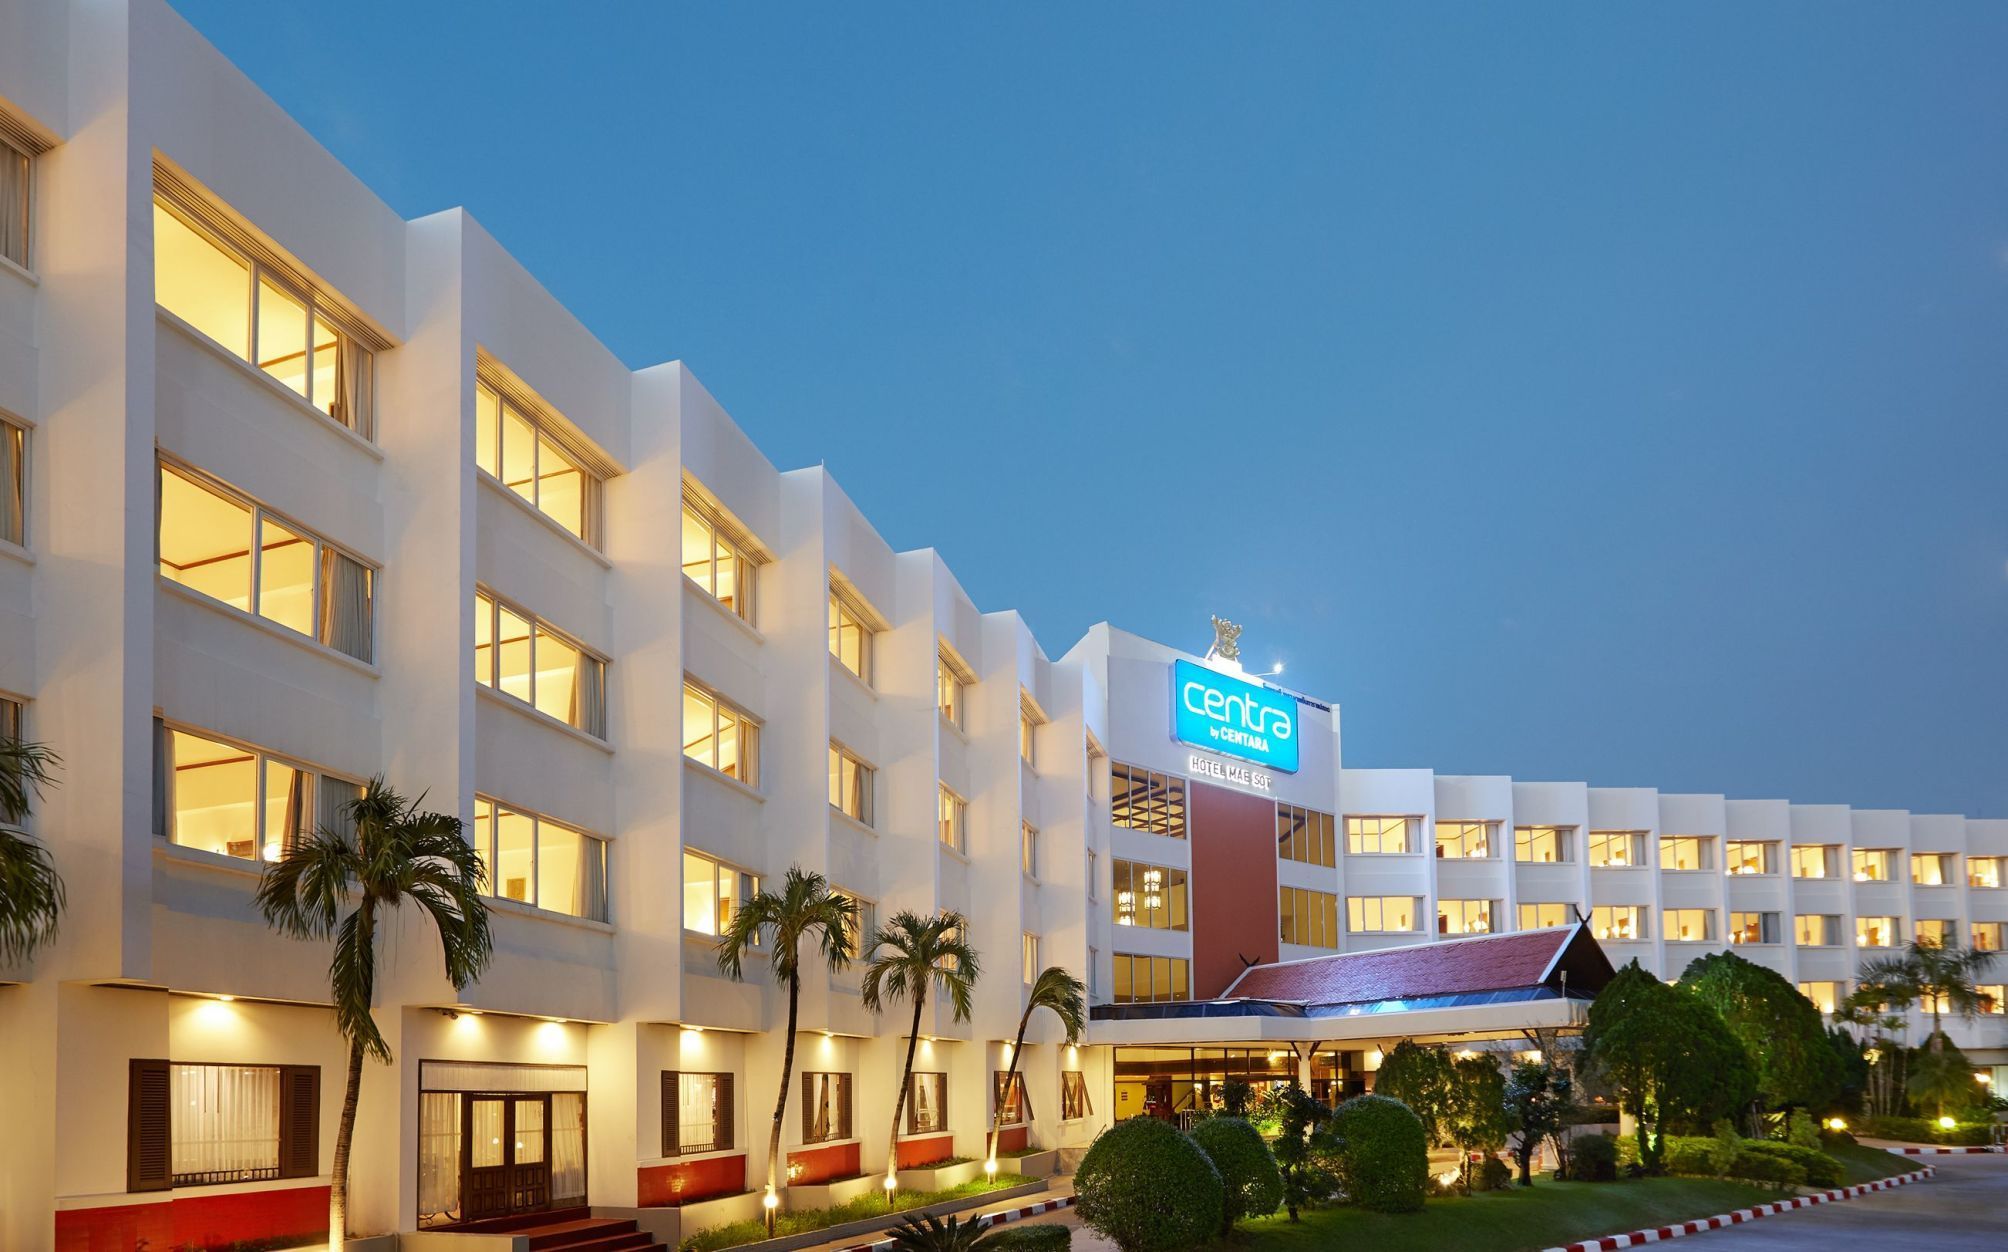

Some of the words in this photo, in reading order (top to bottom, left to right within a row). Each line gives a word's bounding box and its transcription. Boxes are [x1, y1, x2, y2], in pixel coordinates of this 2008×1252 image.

[1184, 681, 1291, 739] centra
[1210, 726, 1219, 740] by
[1220, 726, 1269, 752] CENTARA
[1190, 756, 1225, 779] HOTEL
[1227, 765, 1249, 784] MAE
[1252, 772, 1271, 790] SOT
